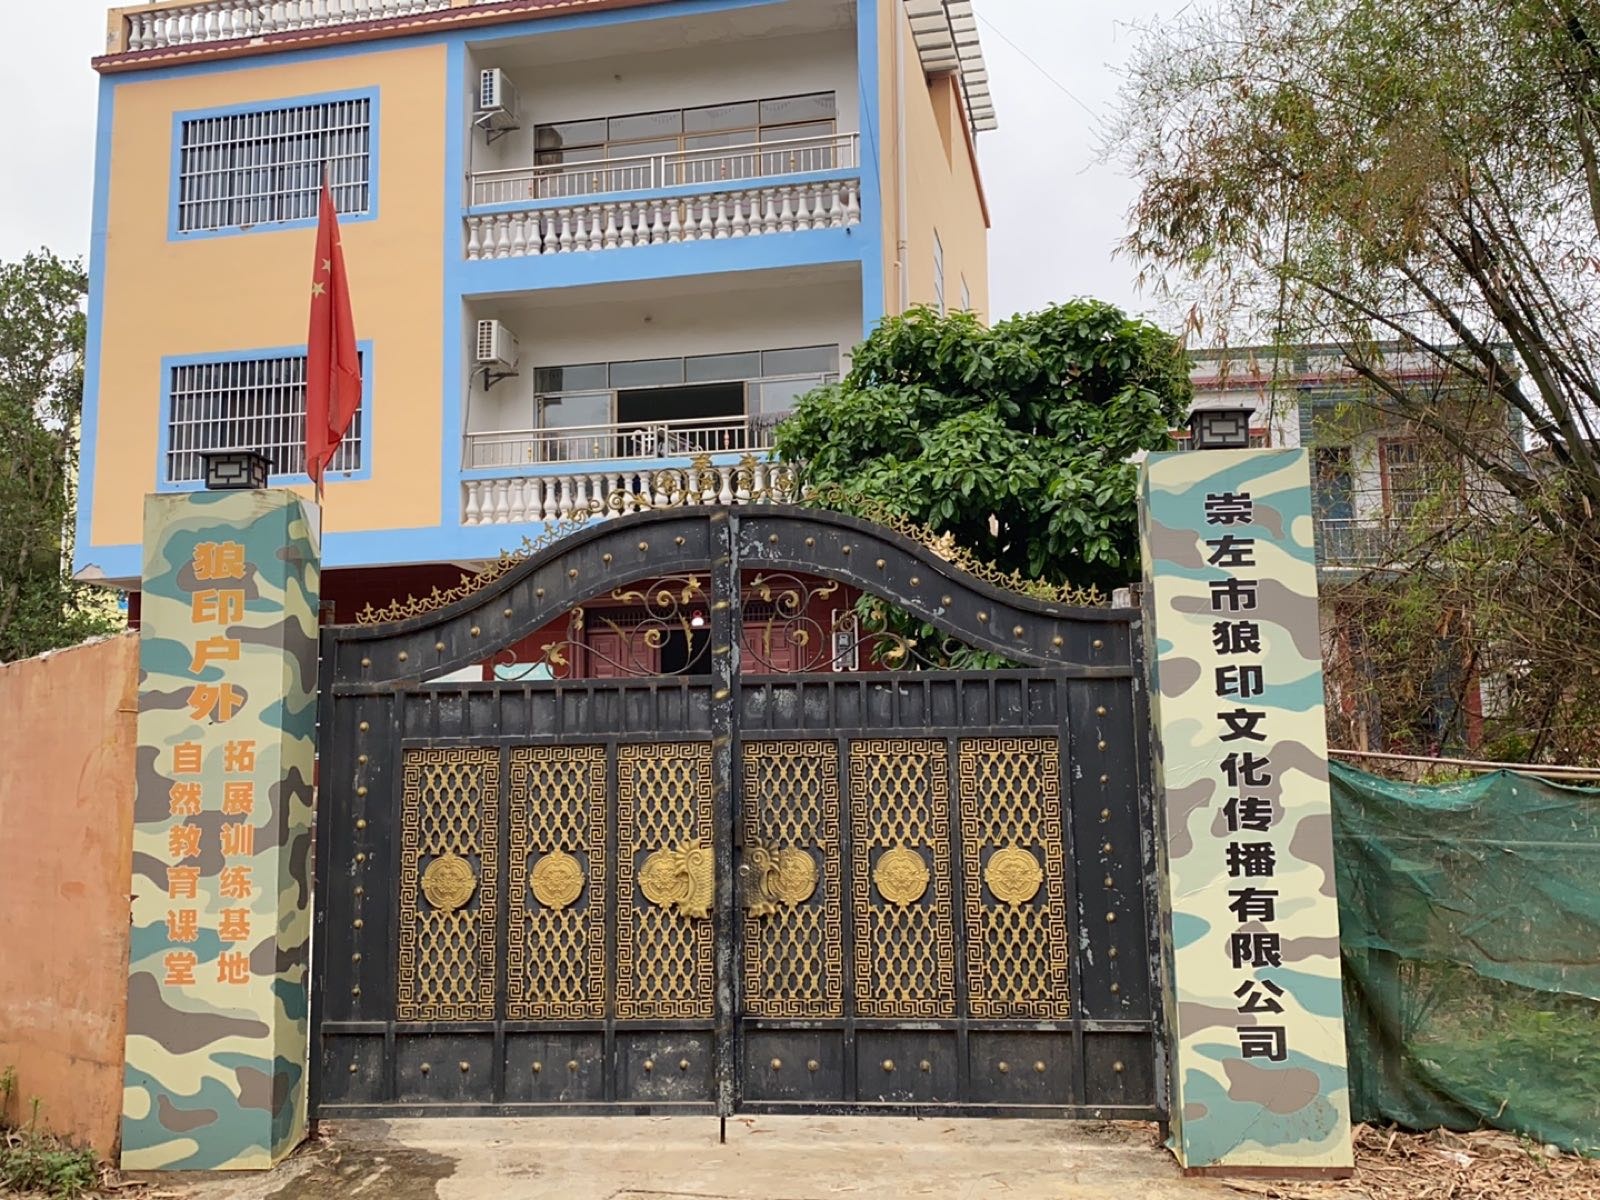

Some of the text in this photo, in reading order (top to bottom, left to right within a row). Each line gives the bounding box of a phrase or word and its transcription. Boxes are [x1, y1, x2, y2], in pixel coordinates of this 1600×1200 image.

[188, 541, 245, 721] 狼印户外
[164, 741, 202, 985] 自然教育课堂
[217, 740, 255, 983] 拓展训练基地
[1204, 491, 1288, 1063] 崇左市狼印文化传播有限公司
